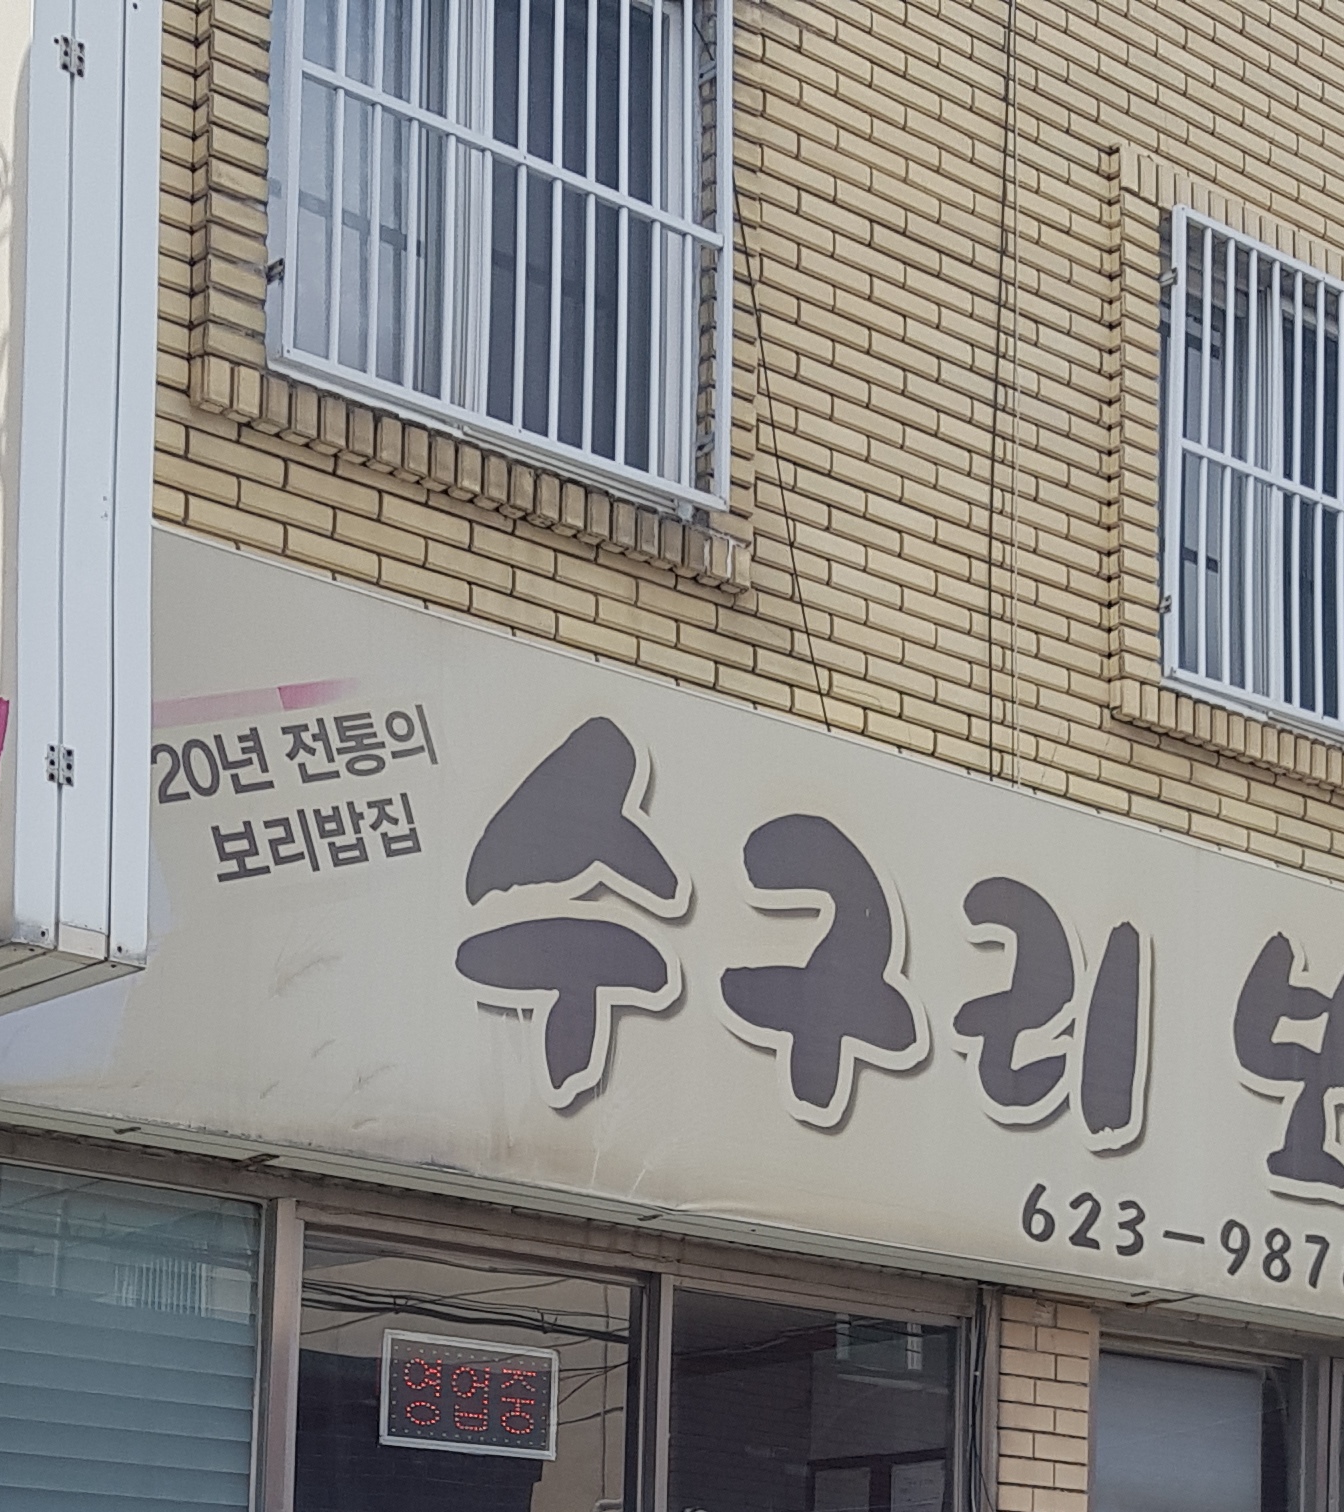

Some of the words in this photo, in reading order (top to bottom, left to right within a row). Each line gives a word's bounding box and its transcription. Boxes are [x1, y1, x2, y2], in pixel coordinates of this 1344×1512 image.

[152, 727, 275, 804] 20년
[281, 704, 439, 784] 전통의
[211, 792, 422, 882] 보리밥집
[455, 716, 1141, 1135] 수구리
[403, 1356, 538, 1436] 영업중
